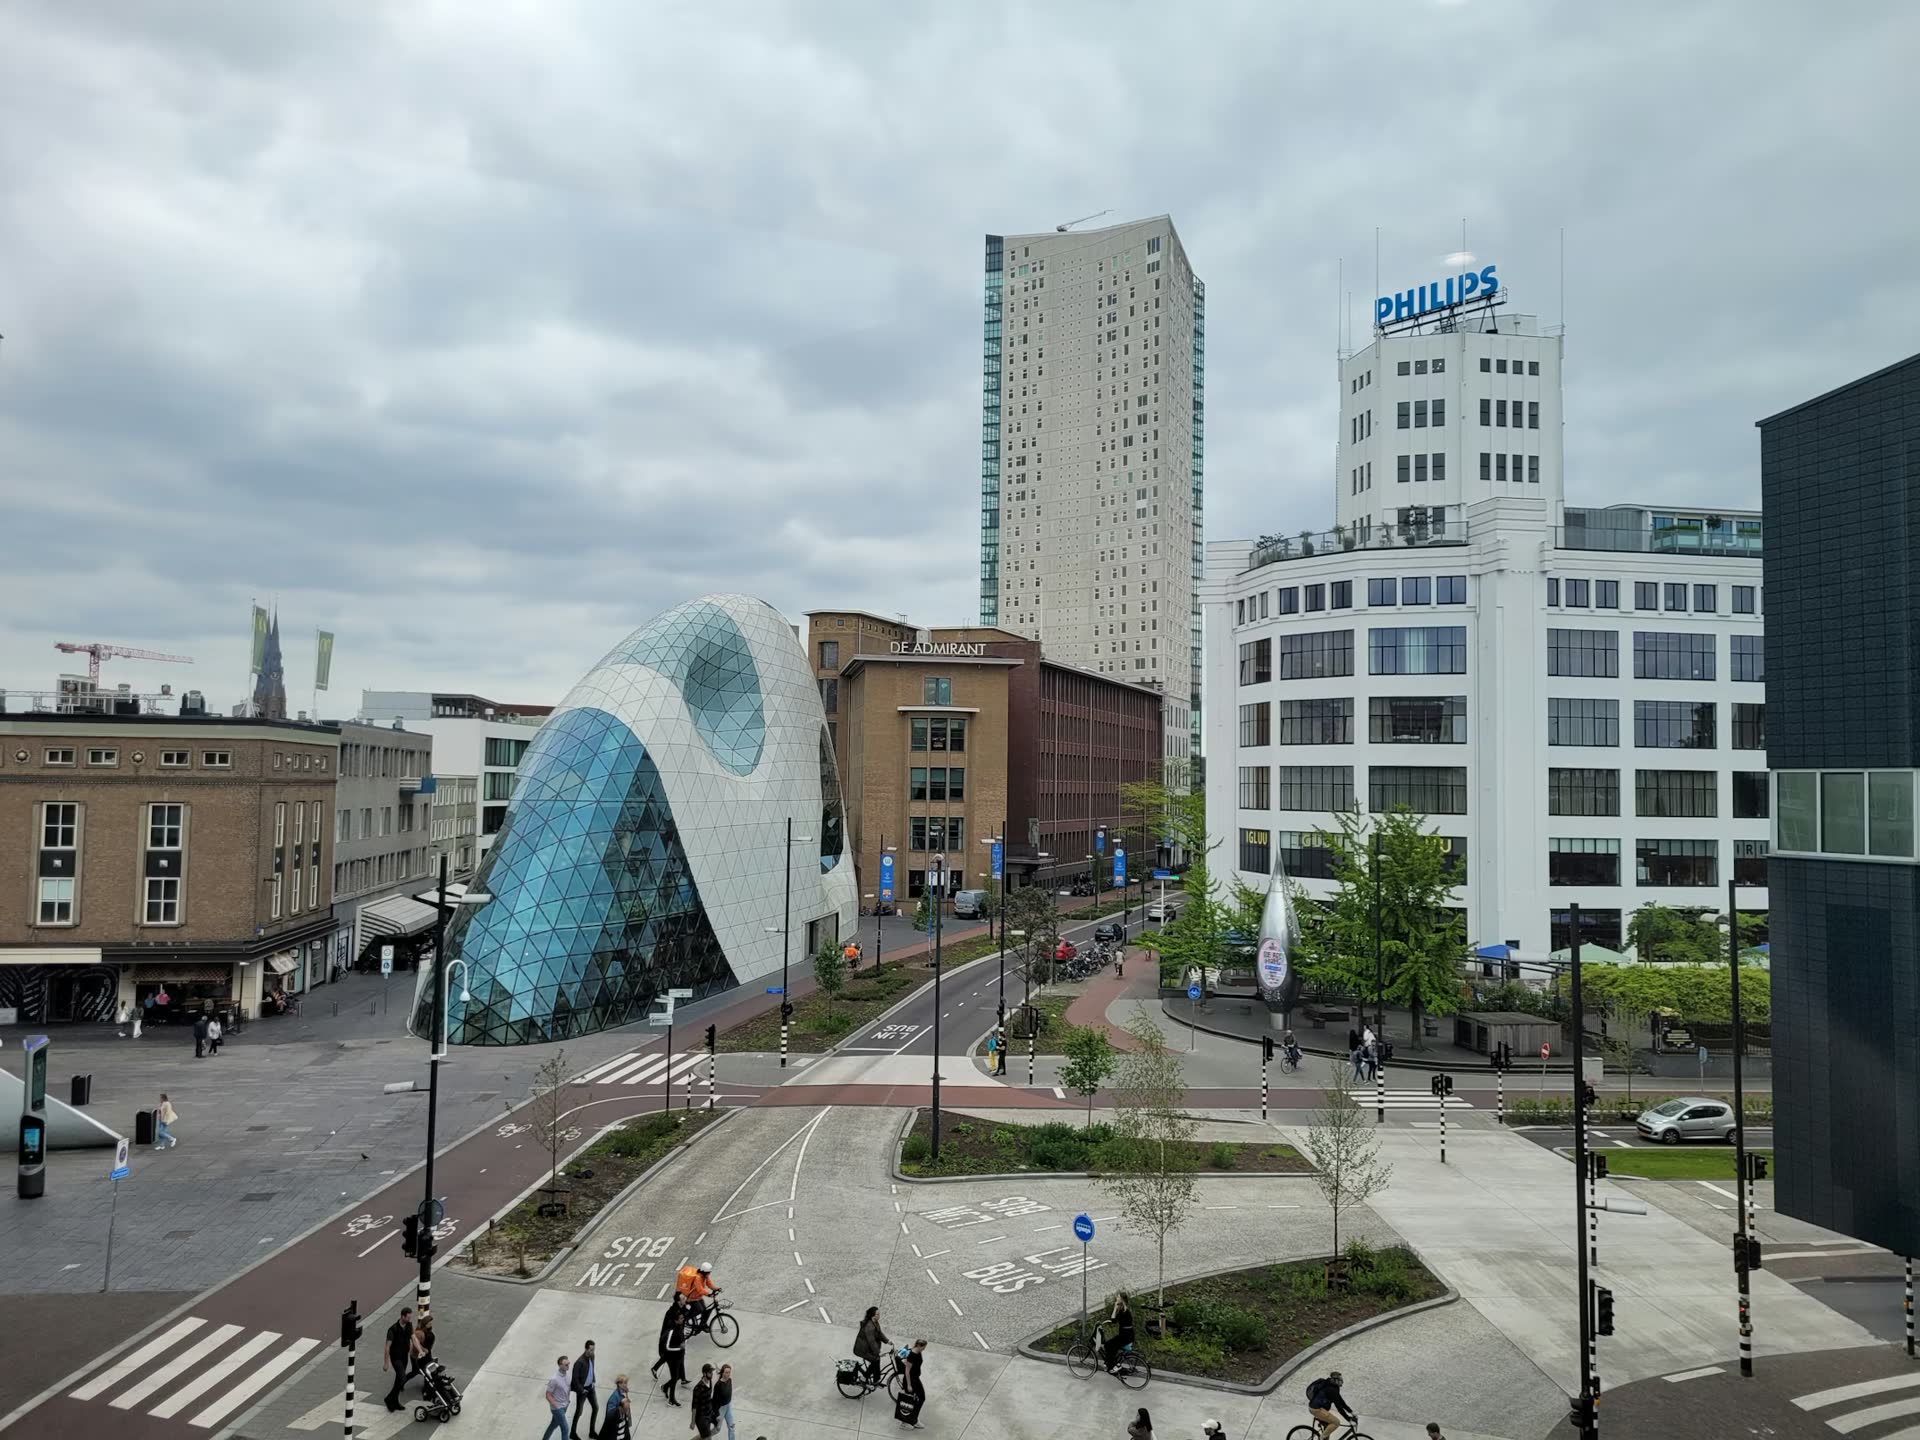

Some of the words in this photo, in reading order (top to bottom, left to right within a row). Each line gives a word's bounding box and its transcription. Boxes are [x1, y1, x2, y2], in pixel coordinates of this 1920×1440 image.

[1375, 265, 1499, 321] PHILIPS
[890, 641, 909, 654] DE
[913, 642, 986, 655] ADMIRANT
[1245, 831, 1268, 845] IGLUU
[883, 1024, 919, 1032] BUS
[981, 1196, 1053, 1217] BUS
[603, 1236, 676, 1259] BUS
[962, 1261, 1046, 1294] BUS
